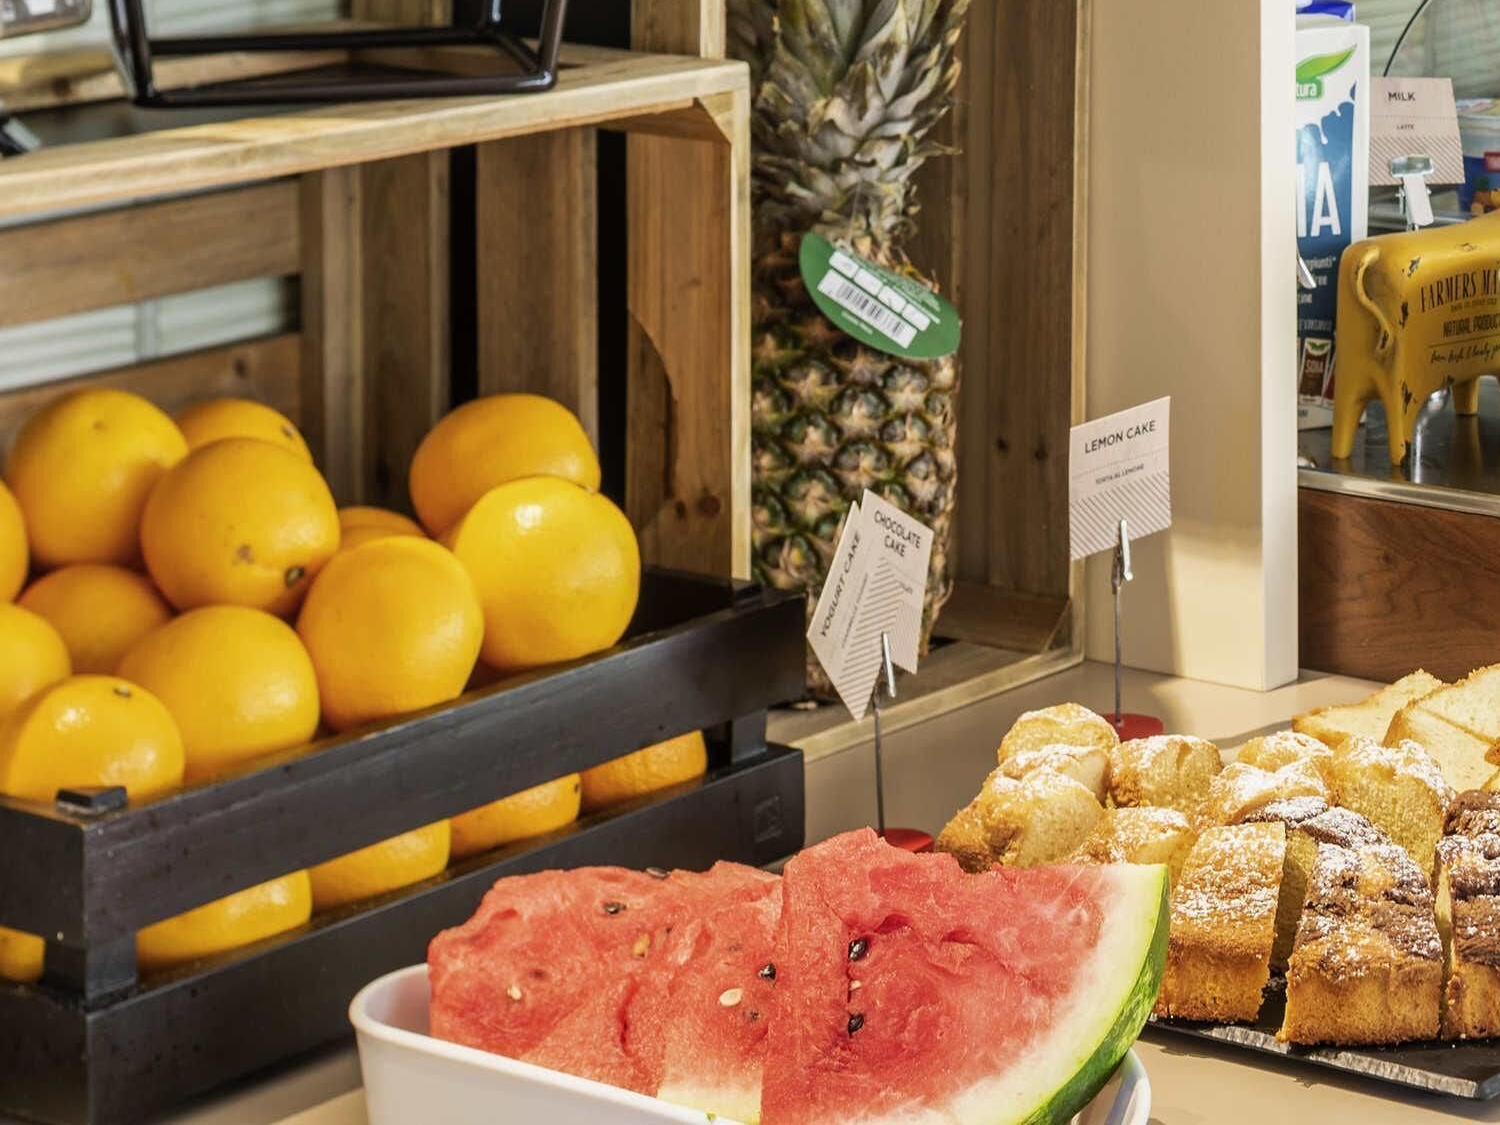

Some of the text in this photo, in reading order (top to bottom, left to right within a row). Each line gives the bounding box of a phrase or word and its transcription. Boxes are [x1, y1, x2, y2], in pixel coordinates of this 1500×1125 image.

[1388, 91, 1416, 101] MILK
[1420, 271, 1477, 313] FARMERS
[1084, 420, 1156, 454] LEMON CAKE
[873, 510, 921, 549] CHOCOLATE
[884, 534, 906, 558] CAKE
[820, 577, 846, 637] YOGURT
[844, 530, 861, 574] CAKE
